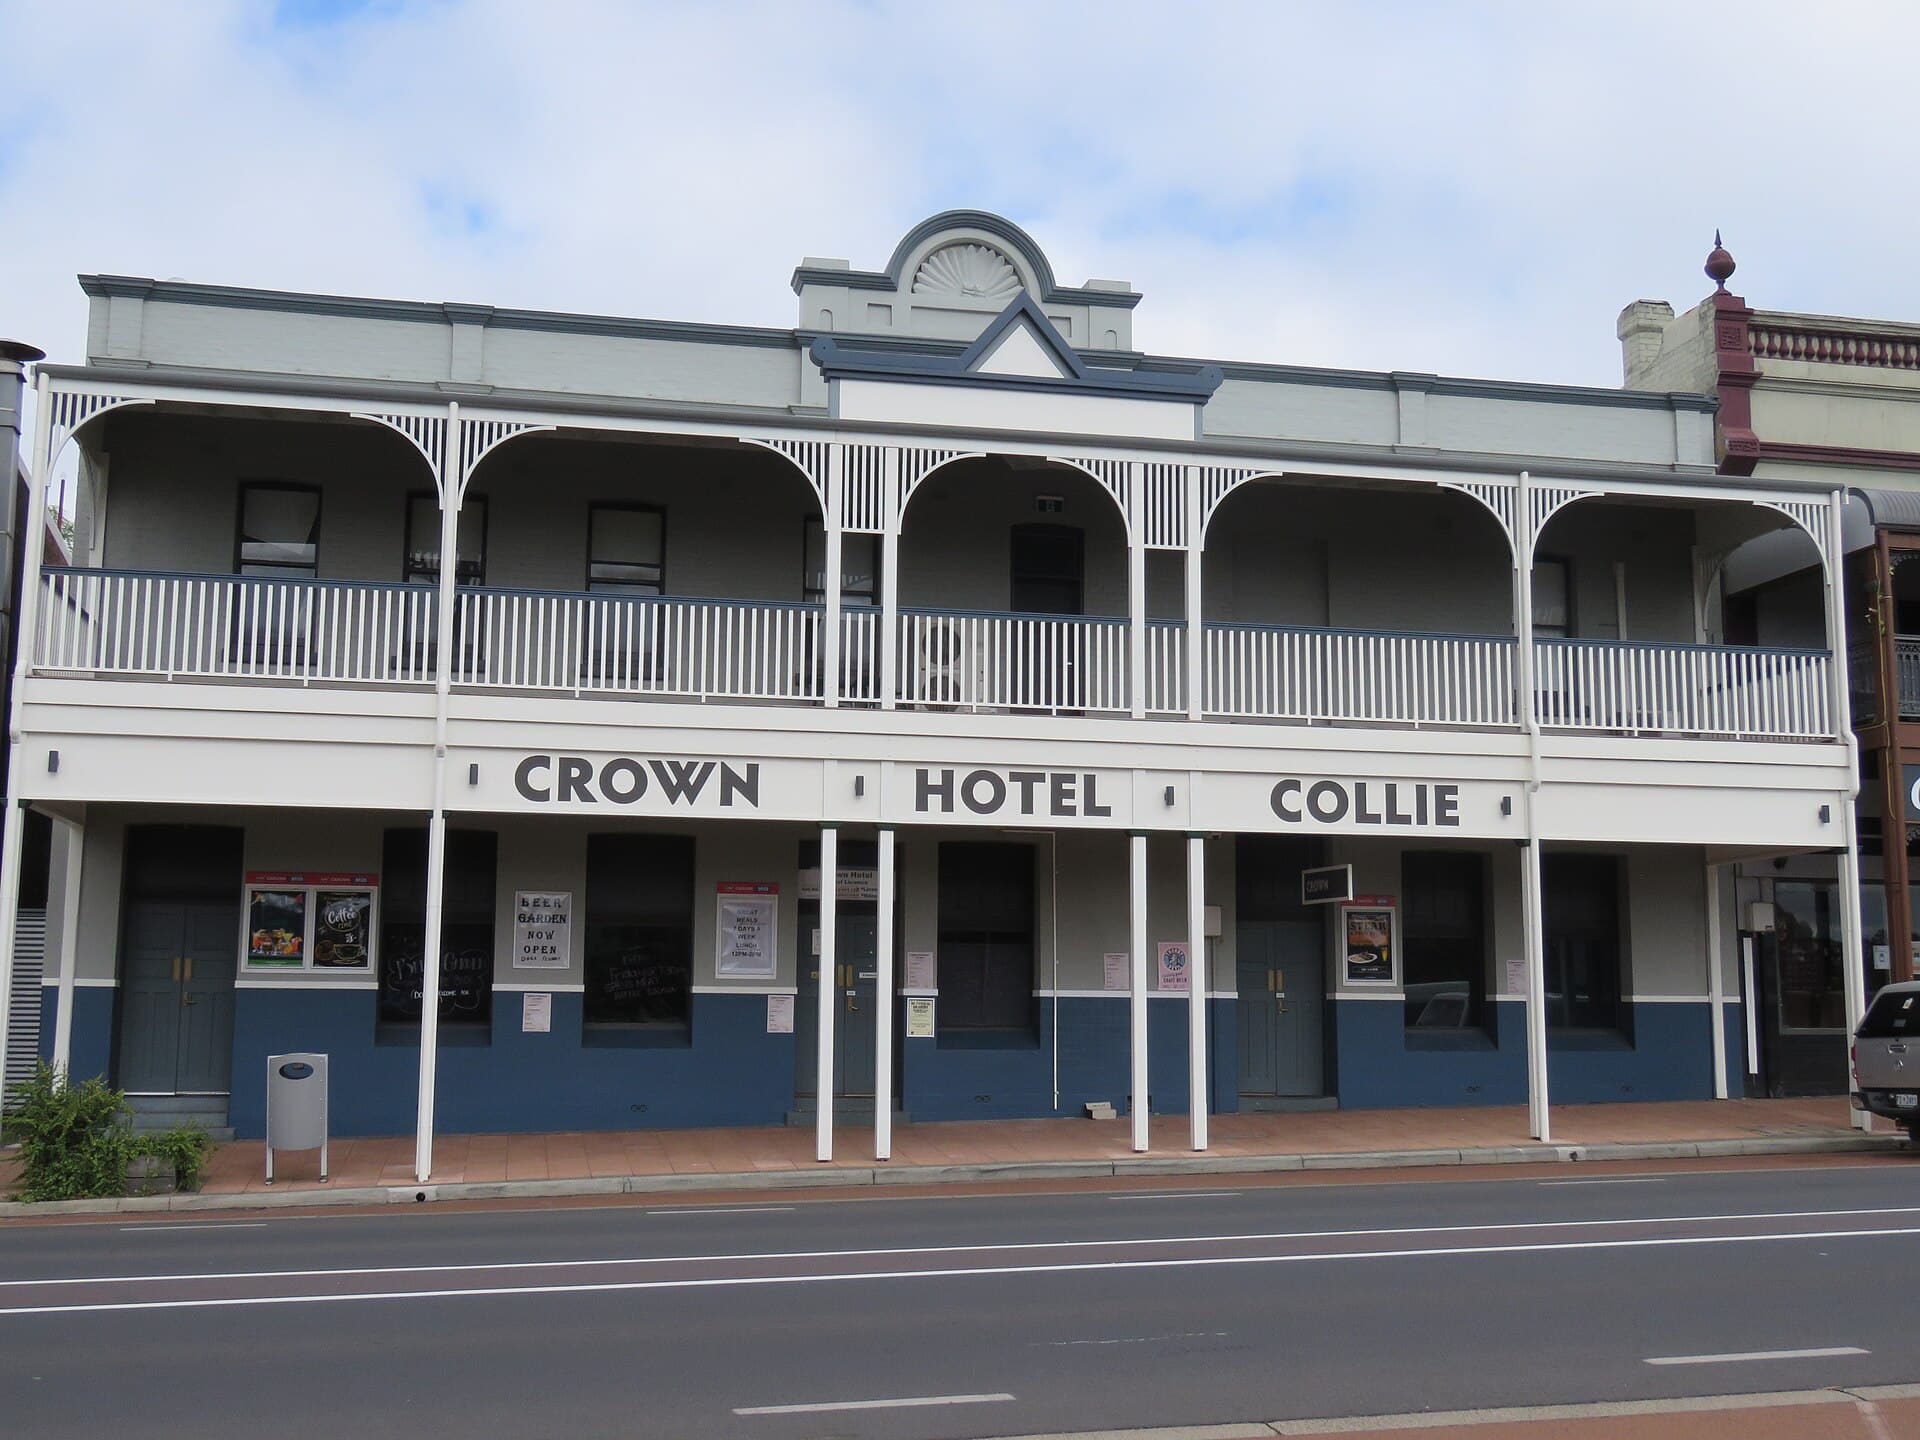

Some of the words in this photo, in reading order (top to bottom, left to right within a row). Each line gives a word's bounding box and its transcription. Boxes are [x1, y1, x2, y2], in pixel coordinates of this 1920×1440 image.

[514, 755, 760, 808] CROWN
[915, 768, 1112, 817] HOTEL
[1270, 778, 1460, 827] COLLIE
[521, 897, 562, 909] BEER
[327, 907, 358, 924] Coffee
[518, 912, 567, 924] GARDEN
[527, 930, 555, 940] NOW
[523, 945, 557, 954] OPEN
